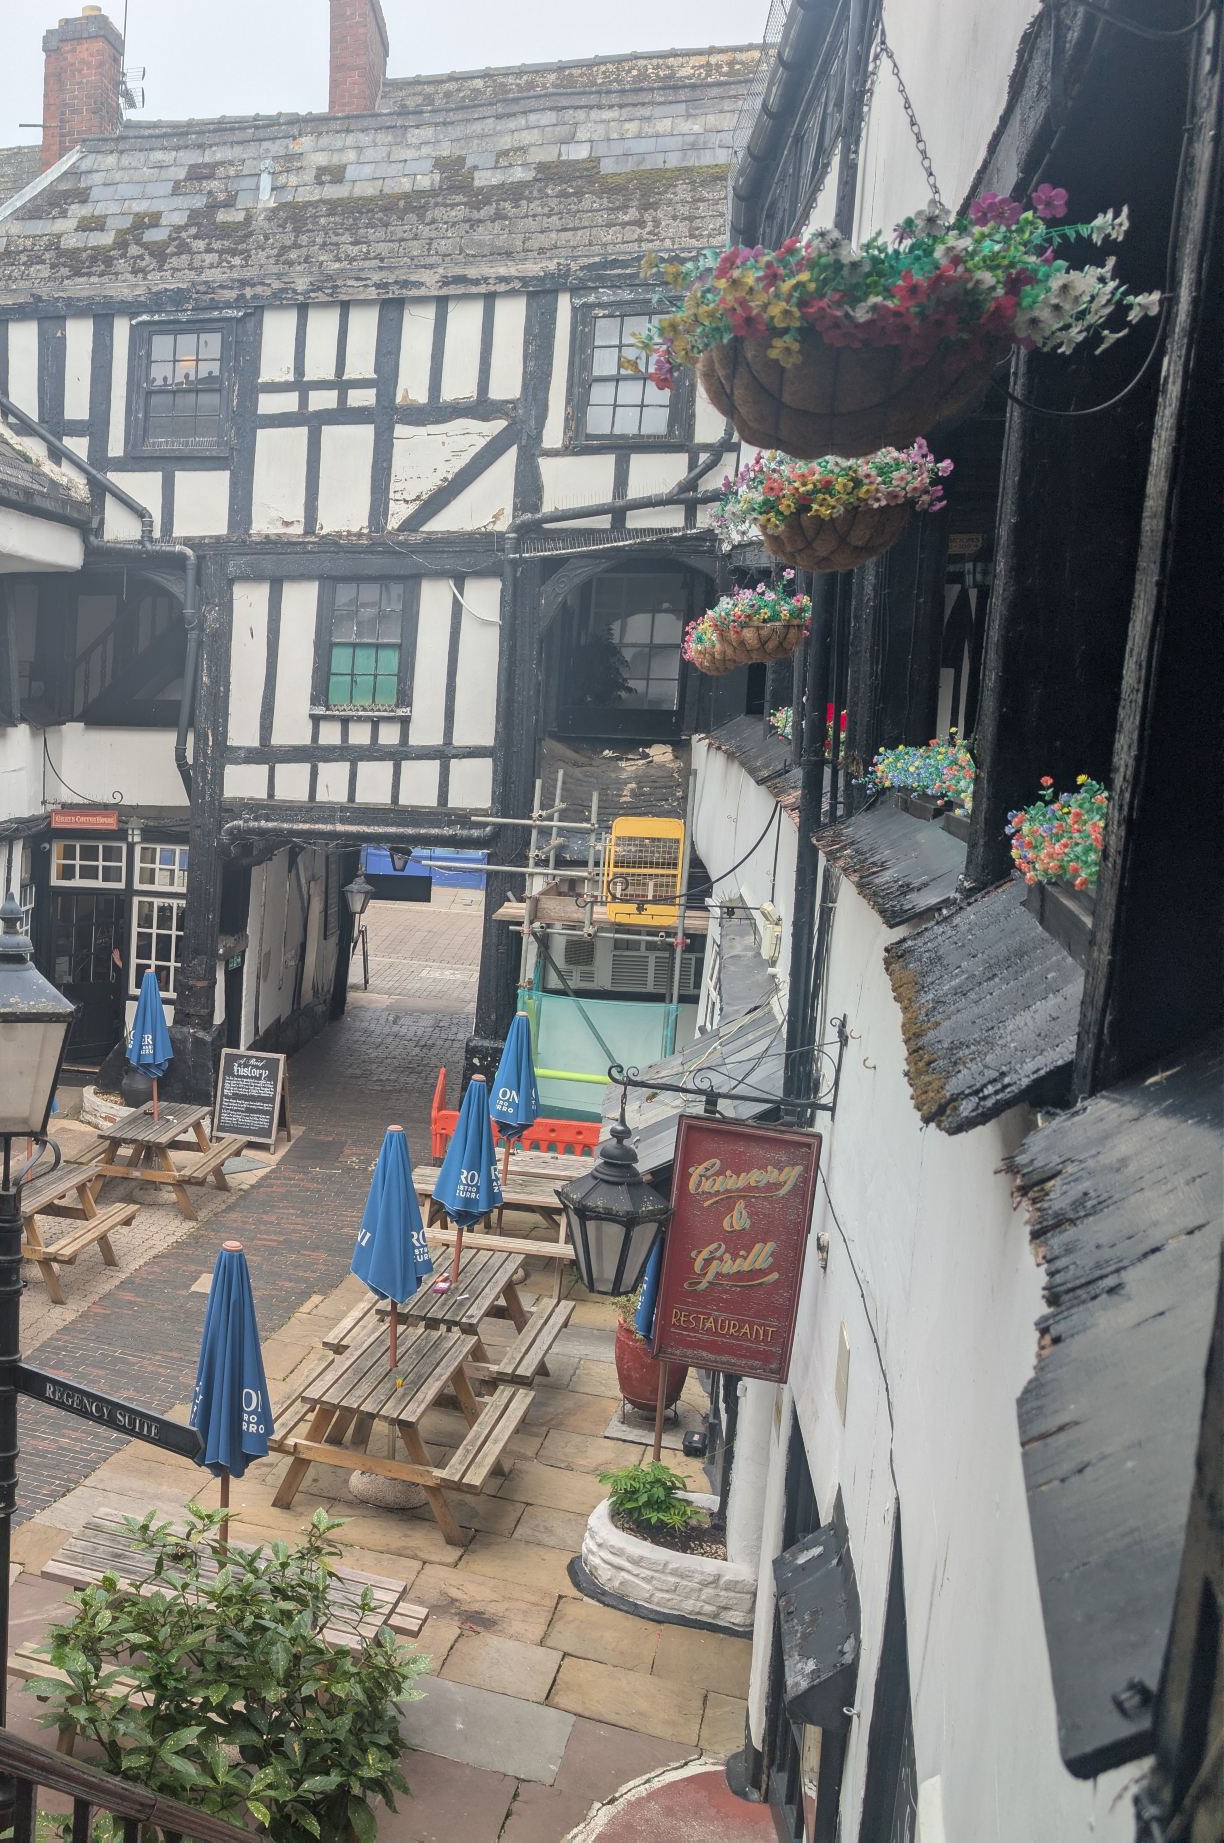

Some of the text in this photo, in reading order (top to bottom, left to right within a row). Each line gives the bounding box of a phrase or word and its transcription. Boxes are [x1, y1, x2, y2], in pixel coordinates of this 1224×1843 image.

[233, 1062, 269, 1080] history
[688, 1158, 804, 1206] Carvery
[722, 1200, 751, 1232] &
[684, 1241, 779, 1291] Grill
[671, 1308, 776, 1342] RESTAURANT
[45, 1382, 161, 1440] REGENCY SUITE
